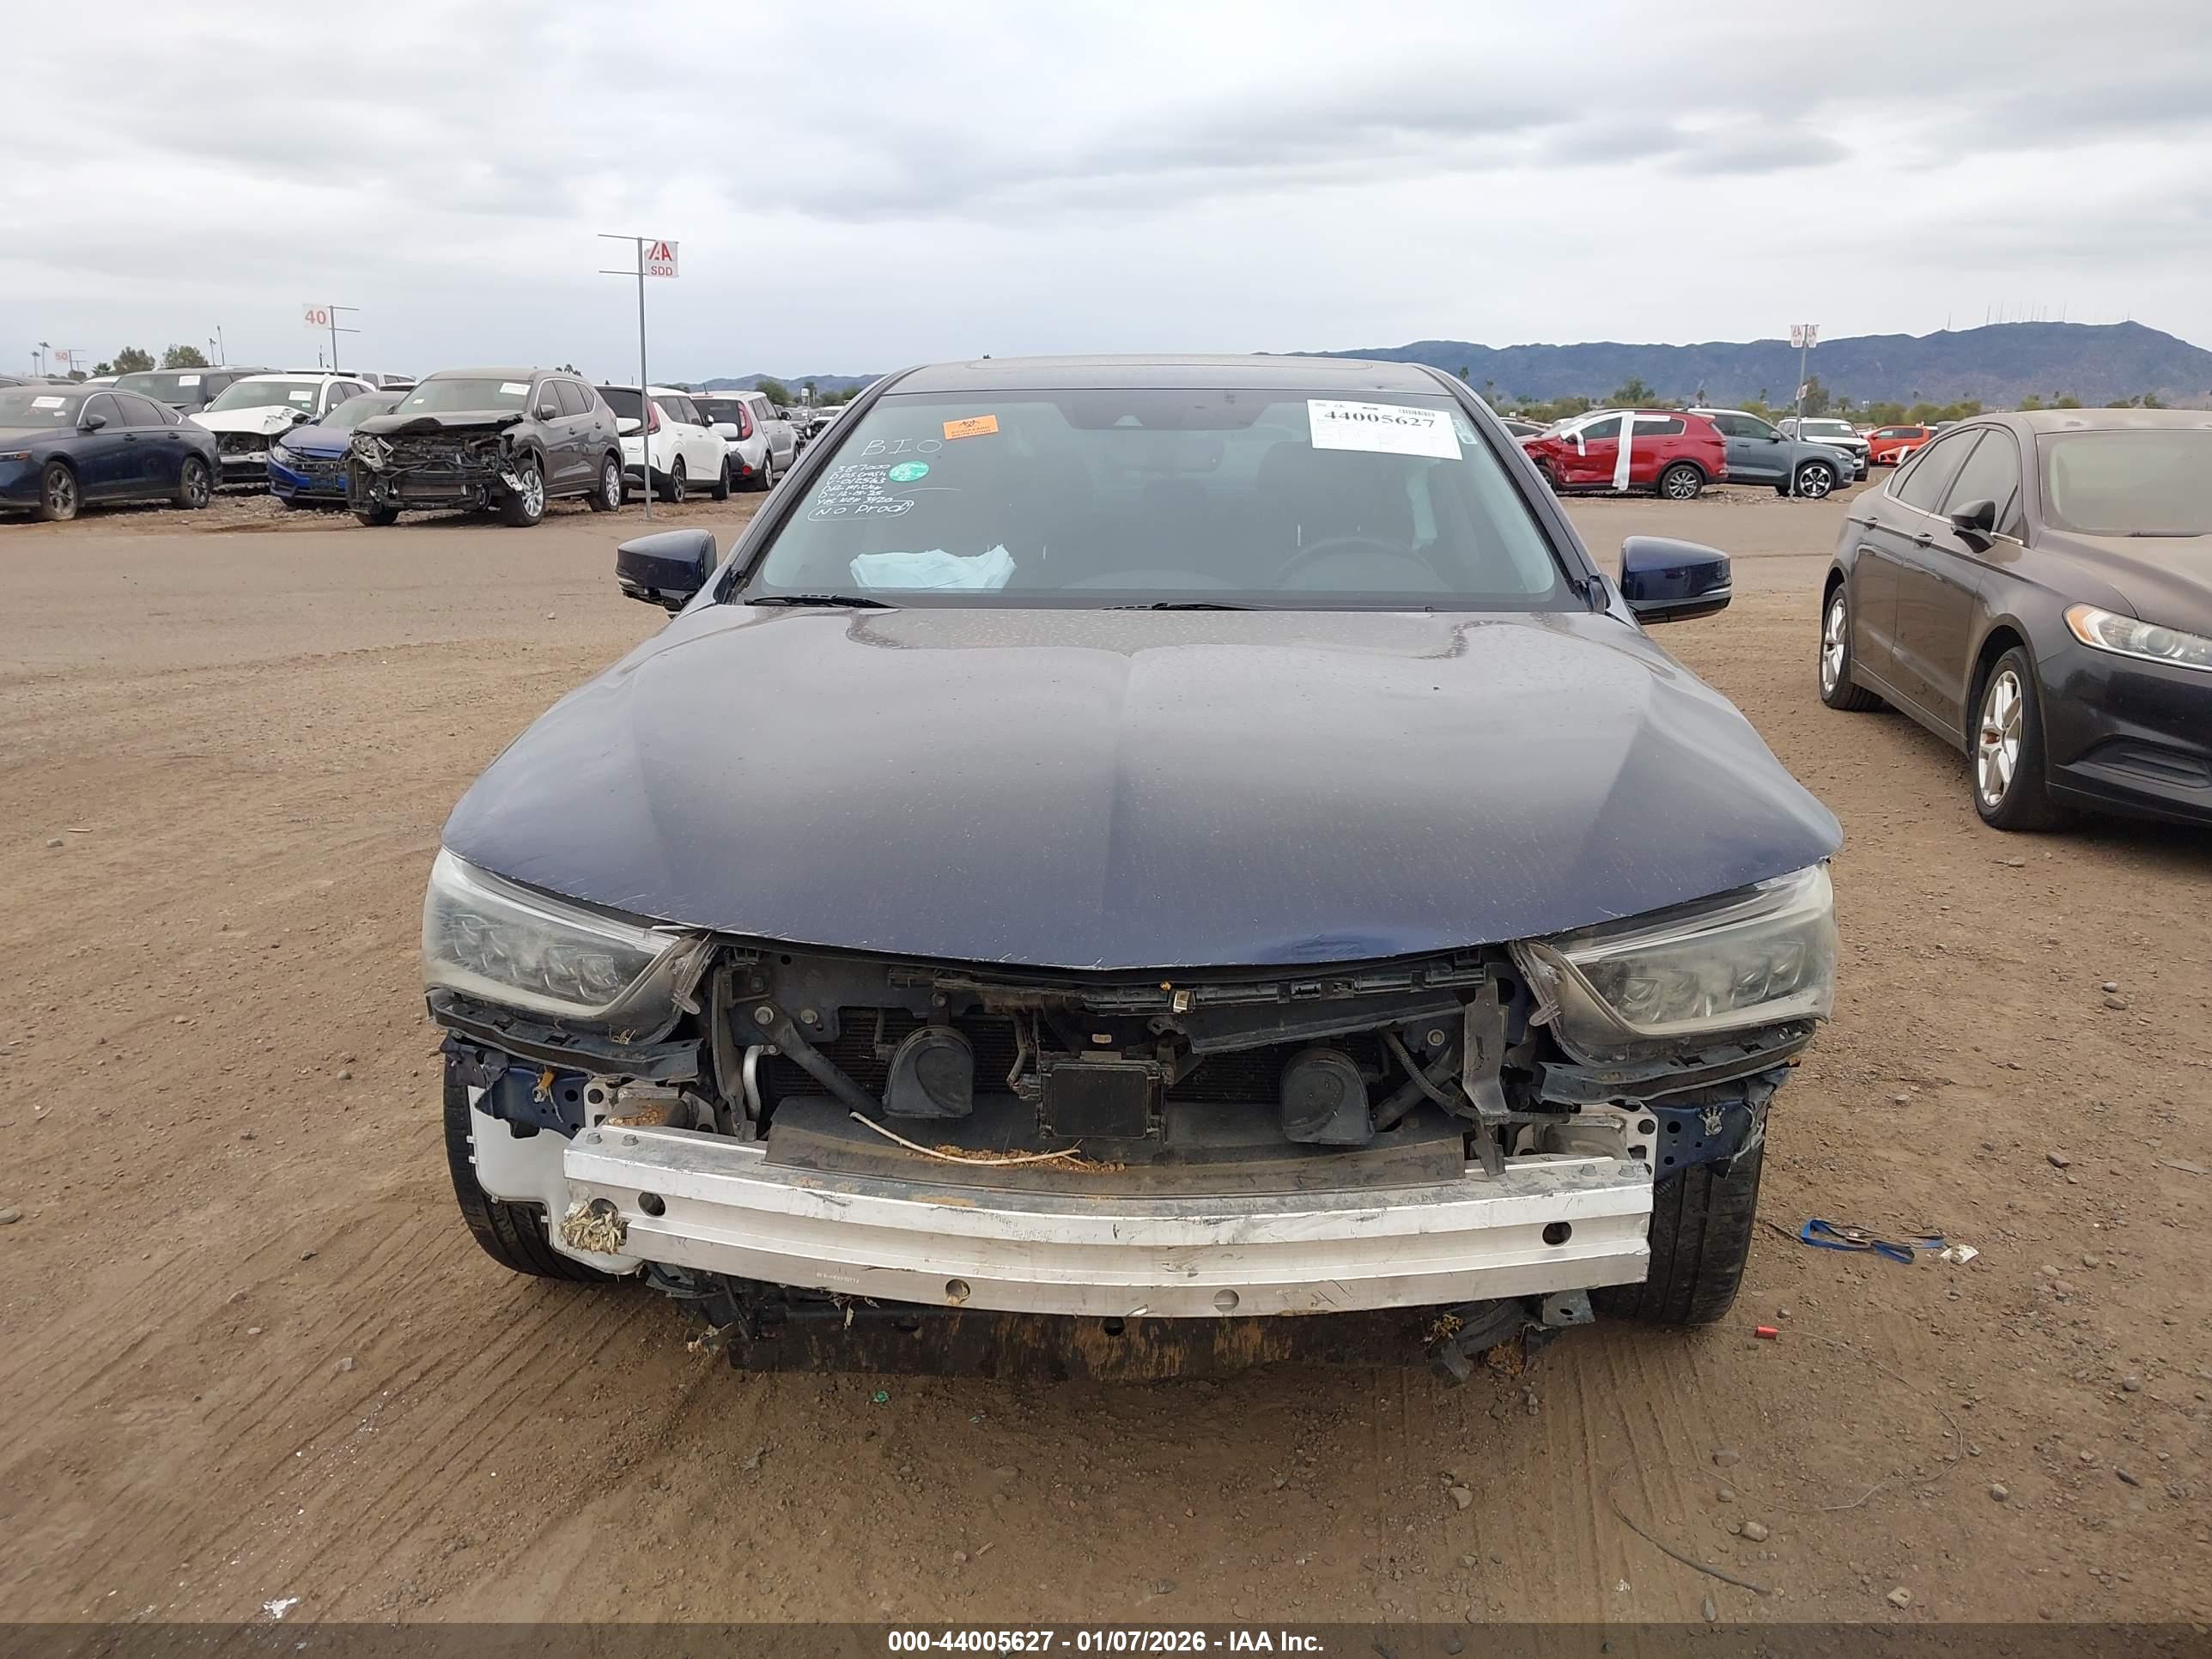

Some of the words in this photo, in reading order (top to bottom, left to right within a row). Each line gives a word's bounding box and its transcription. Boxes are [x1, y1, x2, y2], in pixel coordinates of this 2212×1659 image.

[651, 265, 673, 276] SDD
[305, 309, 326, 325] 40
[1324, 410, 1435, 428] 44005627
[860, 438, 942, 457] BIO
